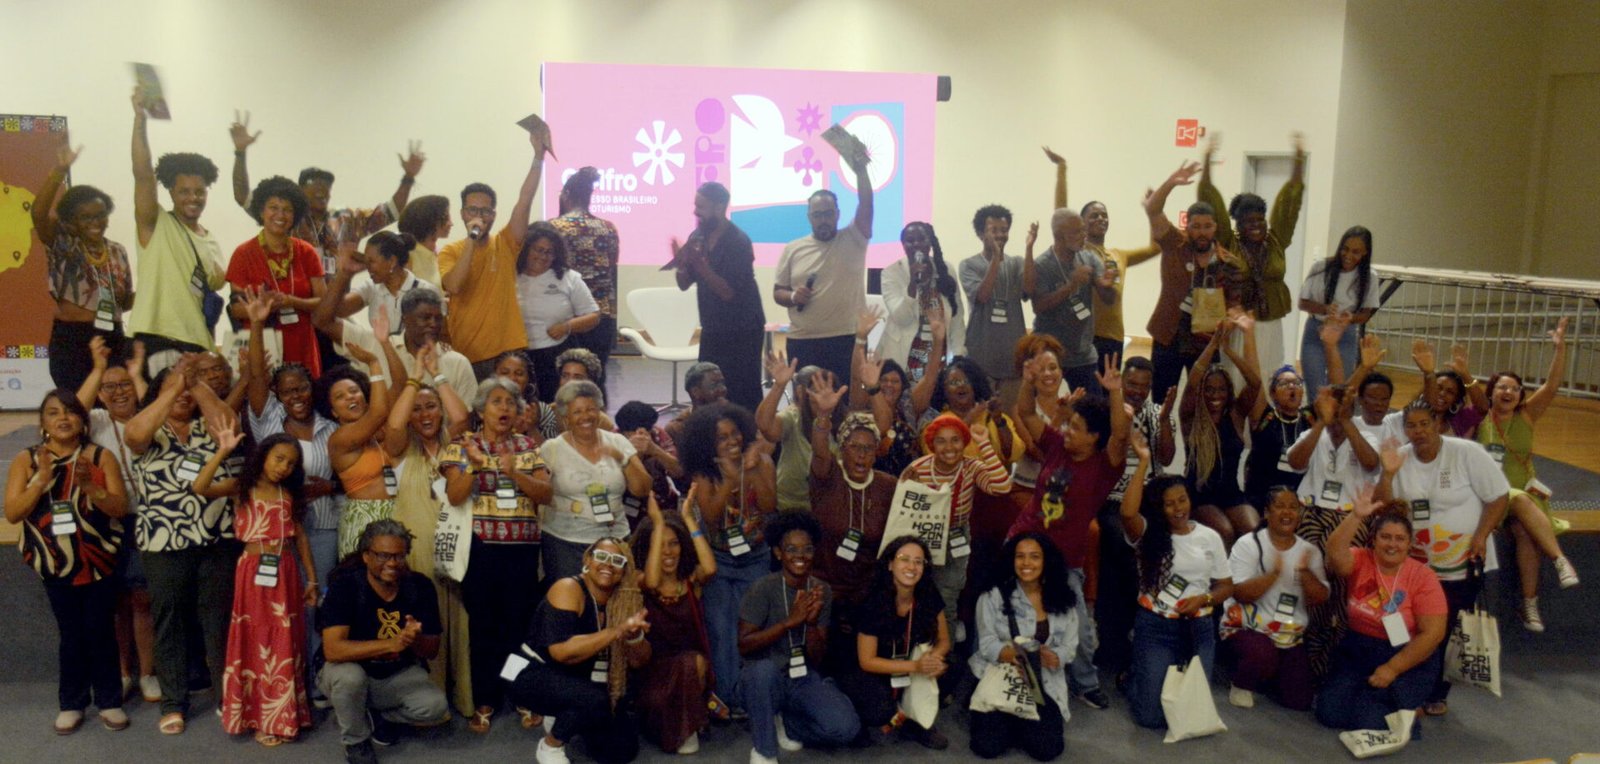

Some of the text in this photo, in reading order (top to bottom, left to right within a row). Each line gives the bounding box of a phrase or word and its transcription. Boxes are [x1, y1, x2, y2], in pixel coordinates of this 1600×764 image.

[612, 195, 658, 205] BRASILEIRO
[906, 490, 928, 502] BE
[902, 499, 931, 511] LOS
[435, 542, 457, 552] ZON
